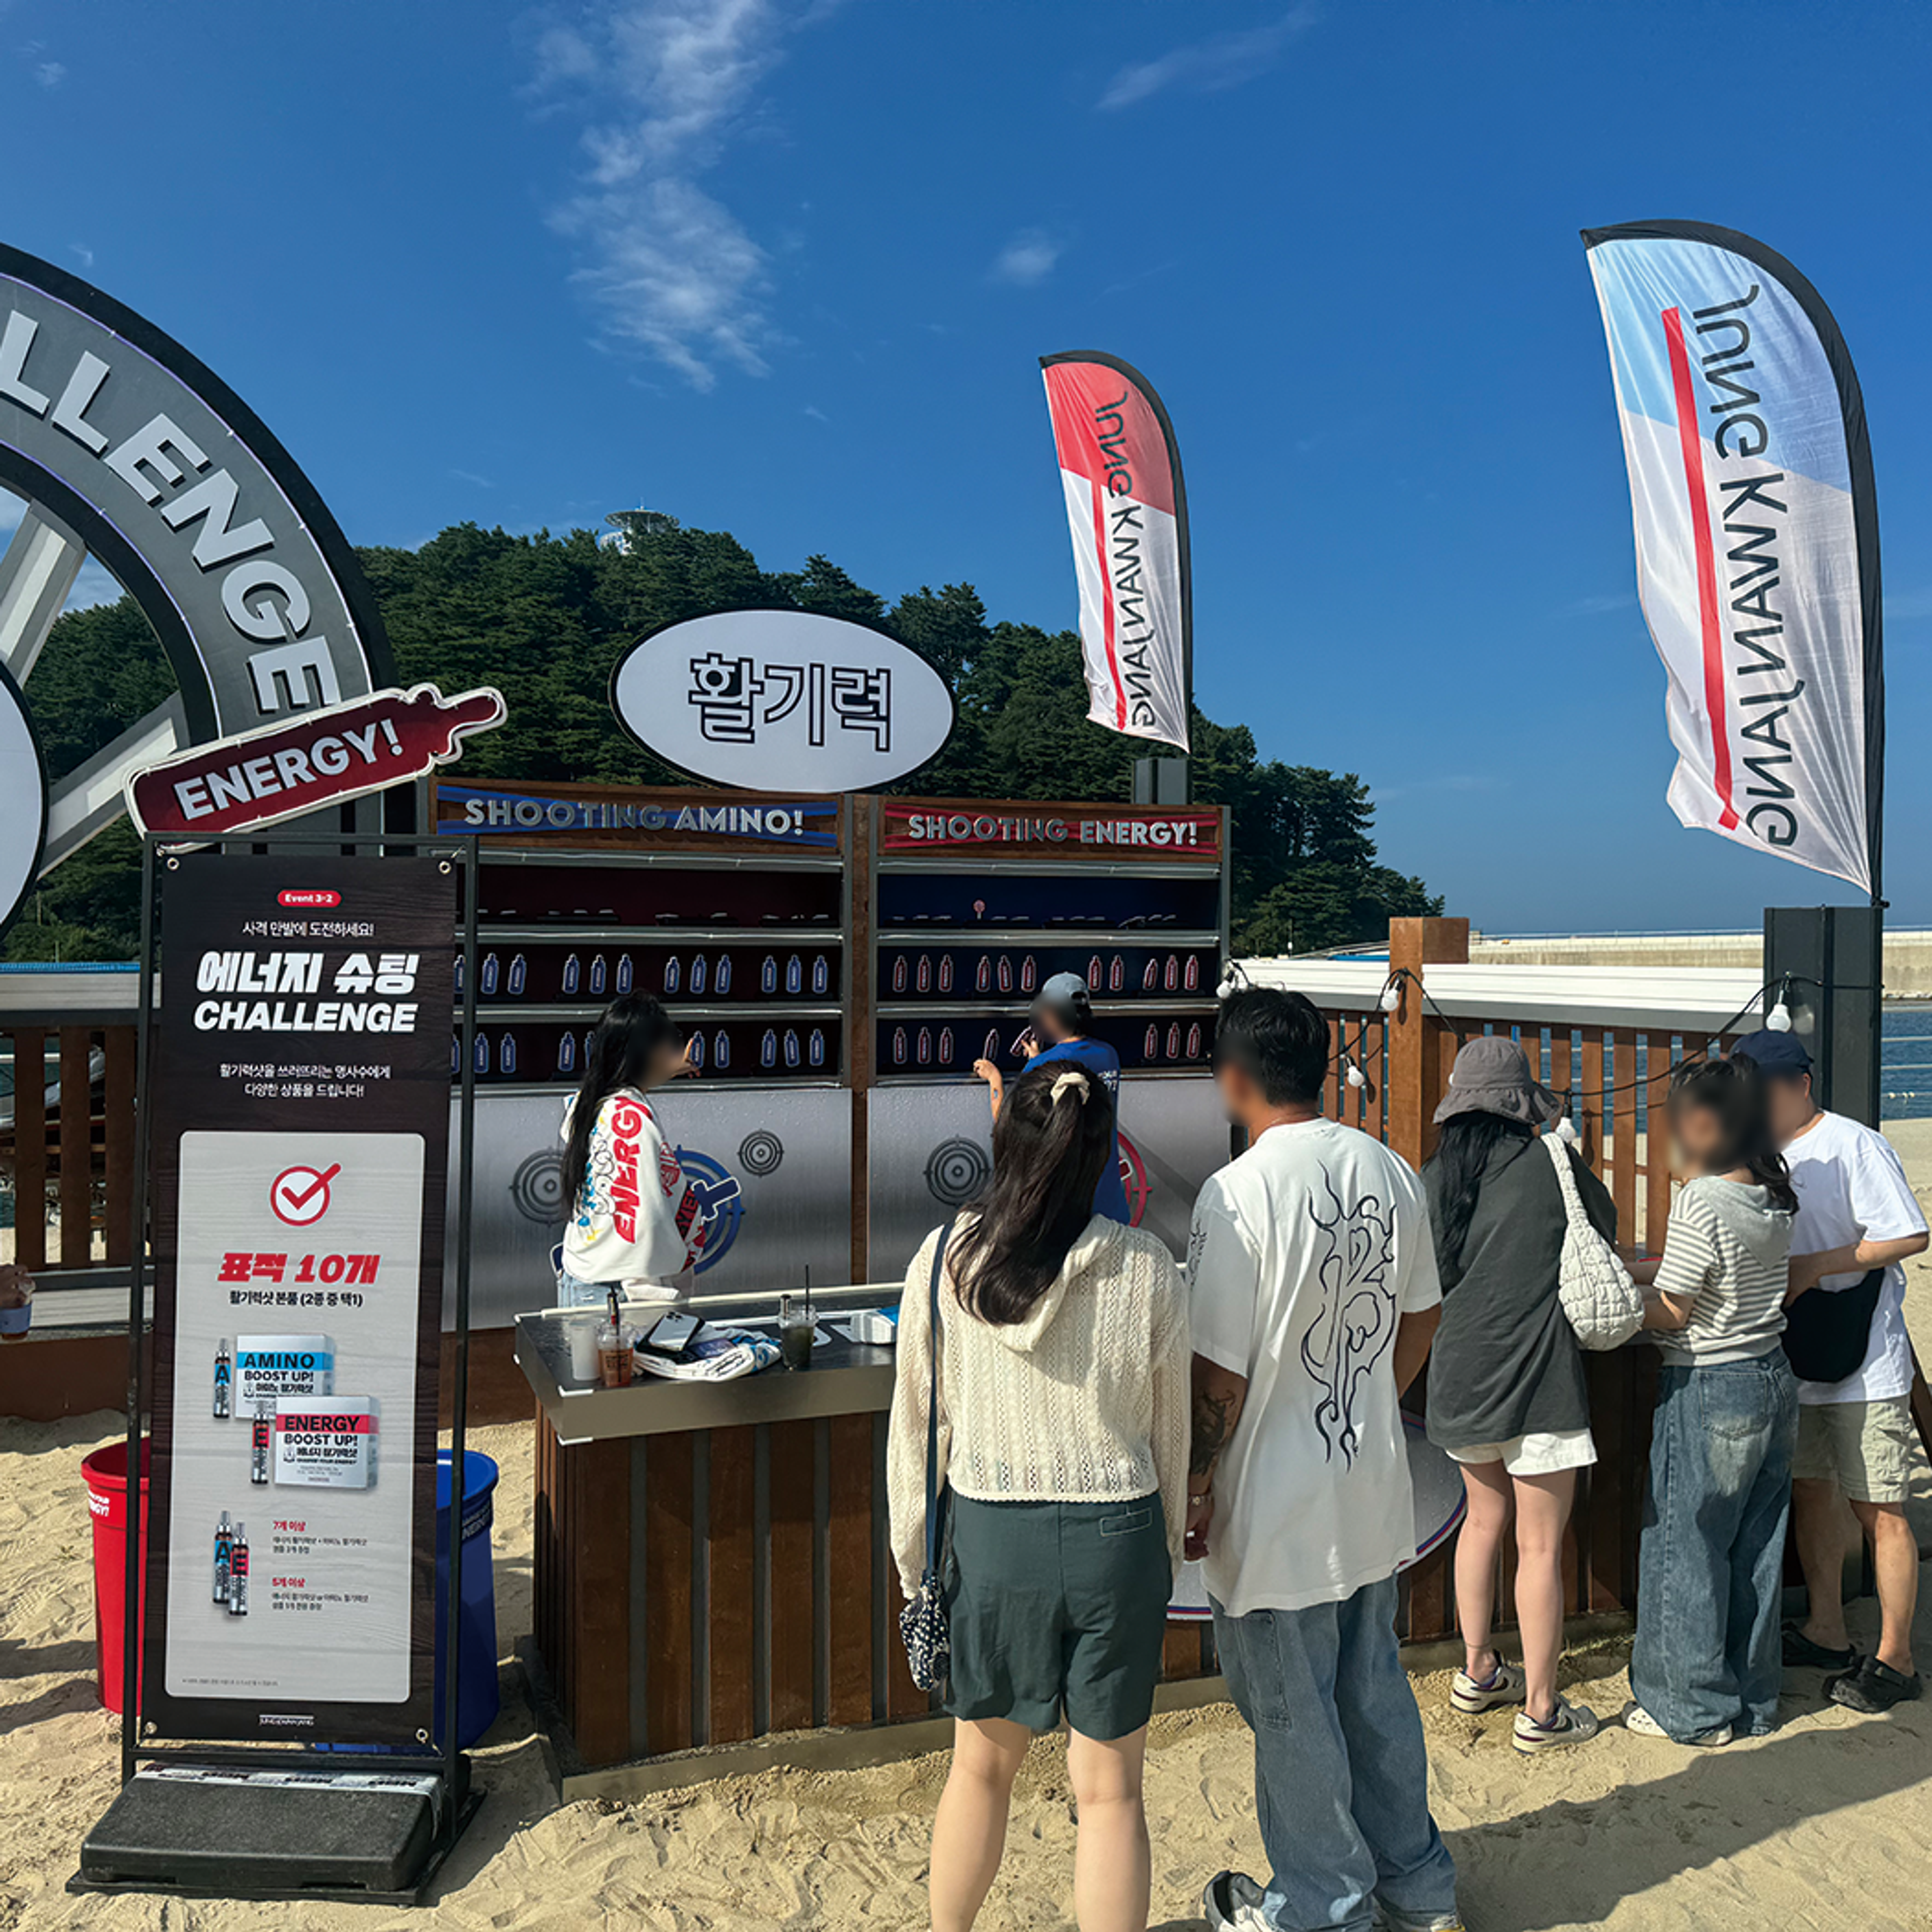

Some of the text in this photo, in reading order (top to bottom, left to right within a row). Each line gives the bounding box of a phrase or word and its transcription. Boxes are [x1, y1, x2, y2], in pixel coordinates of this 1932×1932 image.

[688, 652, 891, 752] 활기력
[174, 718, 404, 821] ENERGY!
[464, 798, 804, 836] SHOOTING AMINO!
[908, 815, 1197, 845] SHOOTING ENERGY!
[285, 894, 333, 903] Event 3-2
[243, 921, 268, 936] 사격
[309, 922, 374, 937] 도전하세요!
[196, 951, 324, 993] 에너지
[333, 953, 420, 994] 슈팅
[194, 1000, 418, 1032] CHALLENGE
[244, 1083, 364, 1098] 다양한 상품을 드립니다!
[610, 1096, 654, 1244] ENERGY
[217, 1253, 381, 1284] 표적 10개
[229, 1291, 274, 1306] 활기력샷
[244, 1353, 315, 1369] AMINO
[215, 1365, 229, 1383] A
[244, 1370, 313, 1382] BOOST UP!
[285, 1415, 360, 1432] ENERGY
[255, 1428, 268, 1447] E
[284, 1433, 358, 1446] BOOST UP!
[215, 1542, 231, 1563] A
[231, 1554, 248, 1576] E
